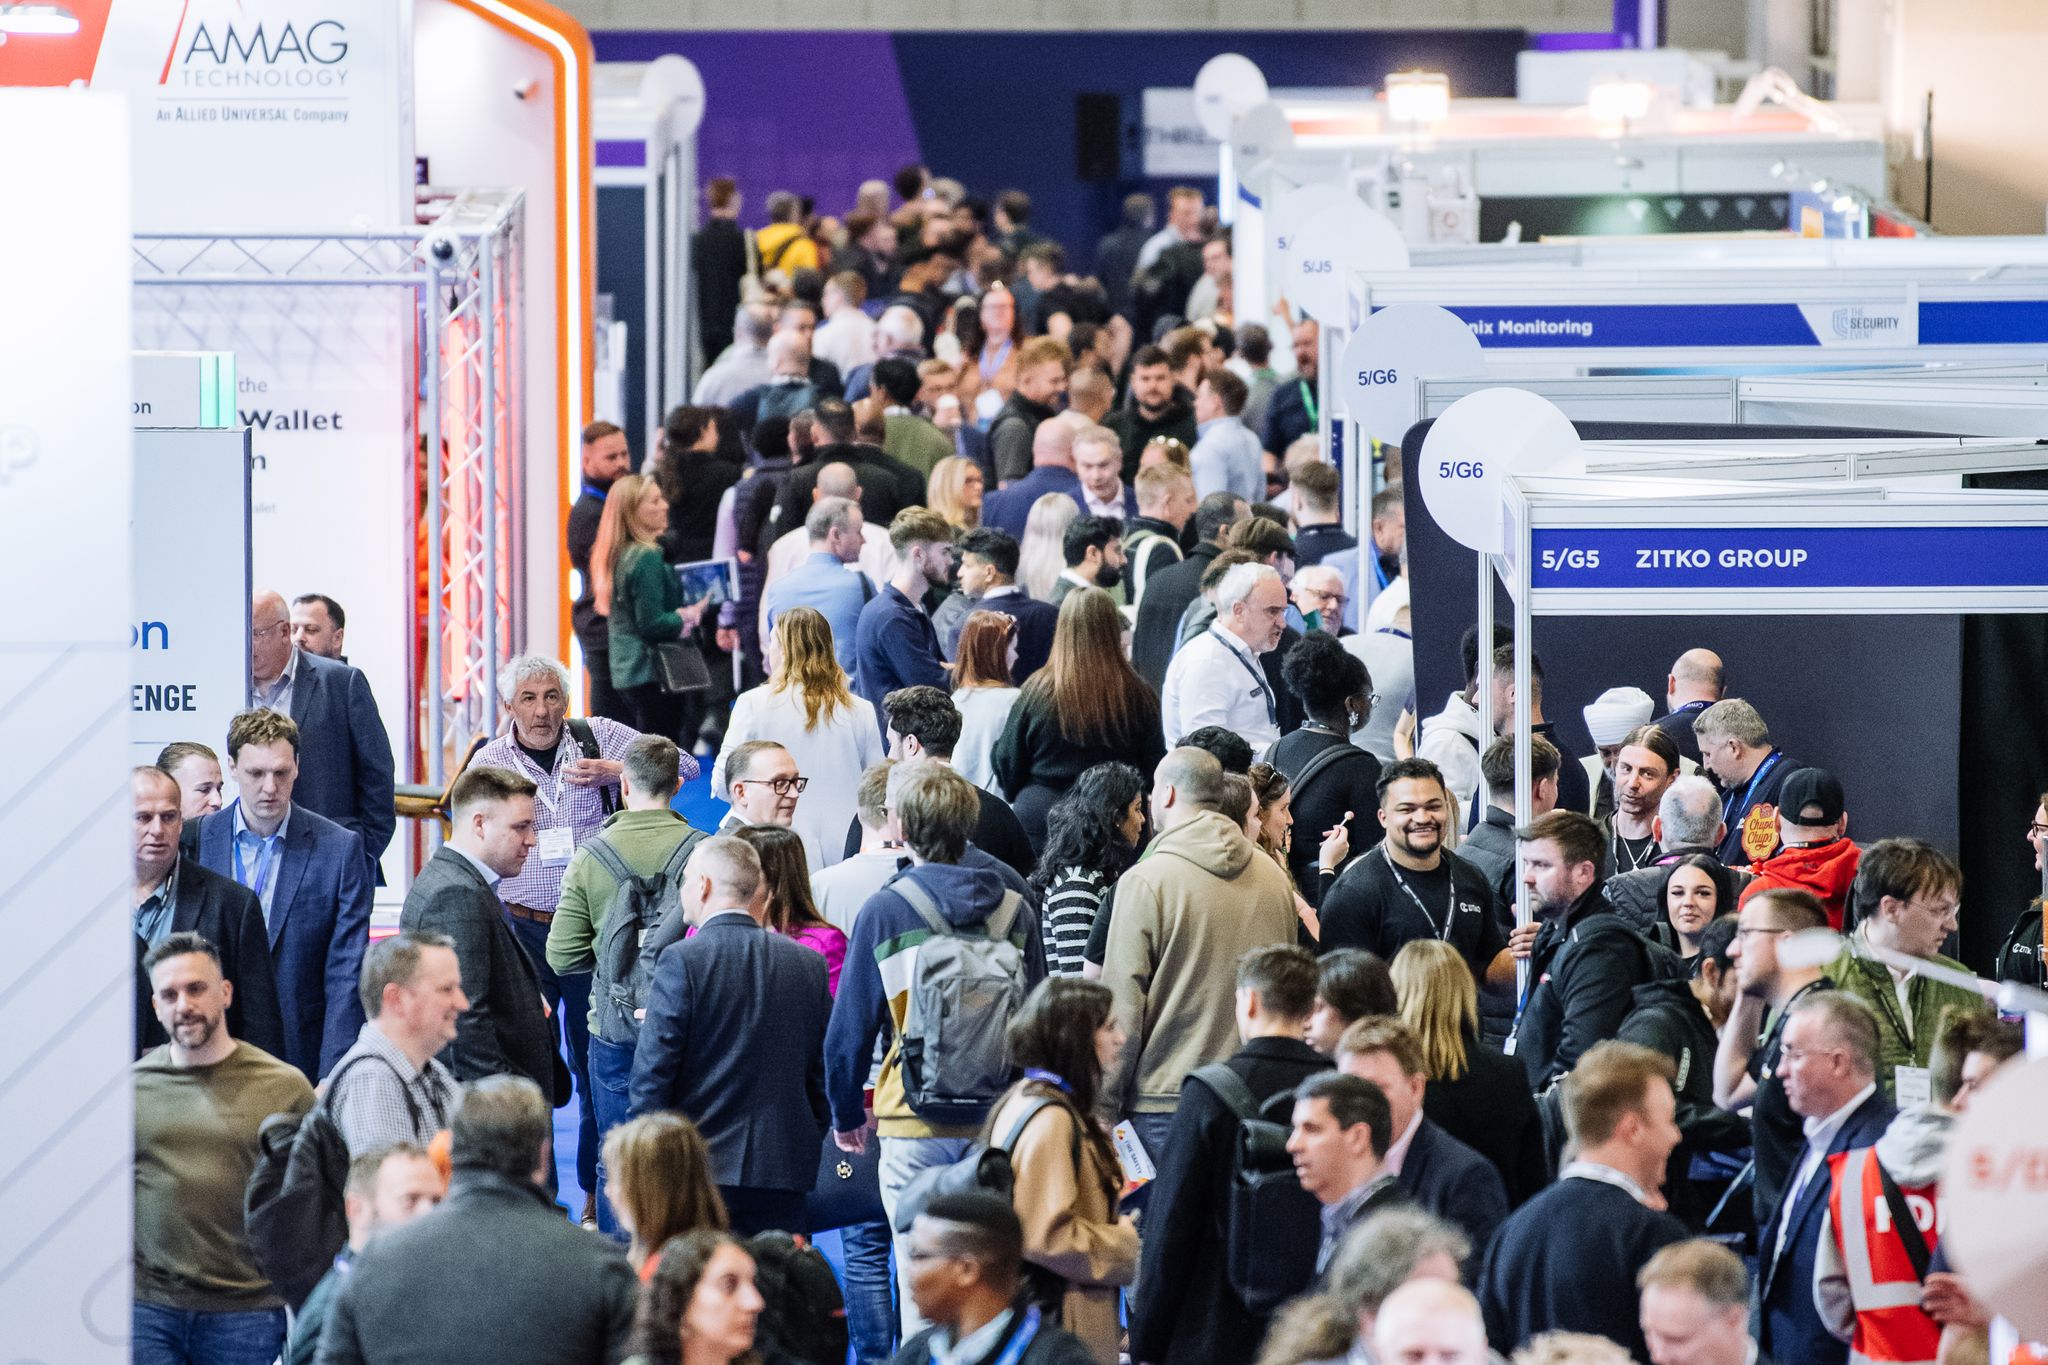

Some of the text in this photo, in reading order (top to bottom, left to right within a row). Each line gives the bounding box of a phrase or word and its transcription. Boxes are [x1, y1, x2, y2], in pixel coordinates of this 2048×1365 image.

[184, 20, 348, 64] AMAG
[181, 69, 348, 87] TECHNOLOGY
[157, 107, 348, 123] An ALLIED UNIVERSAL Company
[1499, 319, 1593, 337] Monitoring
[1850, 317, 1899, 330] SECURITY
[238, 377, 268, 393] the
[1358, 369, 1397, 386] 5/G6
[239, 409, 343, 431] Wallet
[1439, 461, 1484, 479] 5/G6
[1541, 547, 1600, 571] 5/G5
[1635, 549, 1808, 568] ZITKO GROUP
